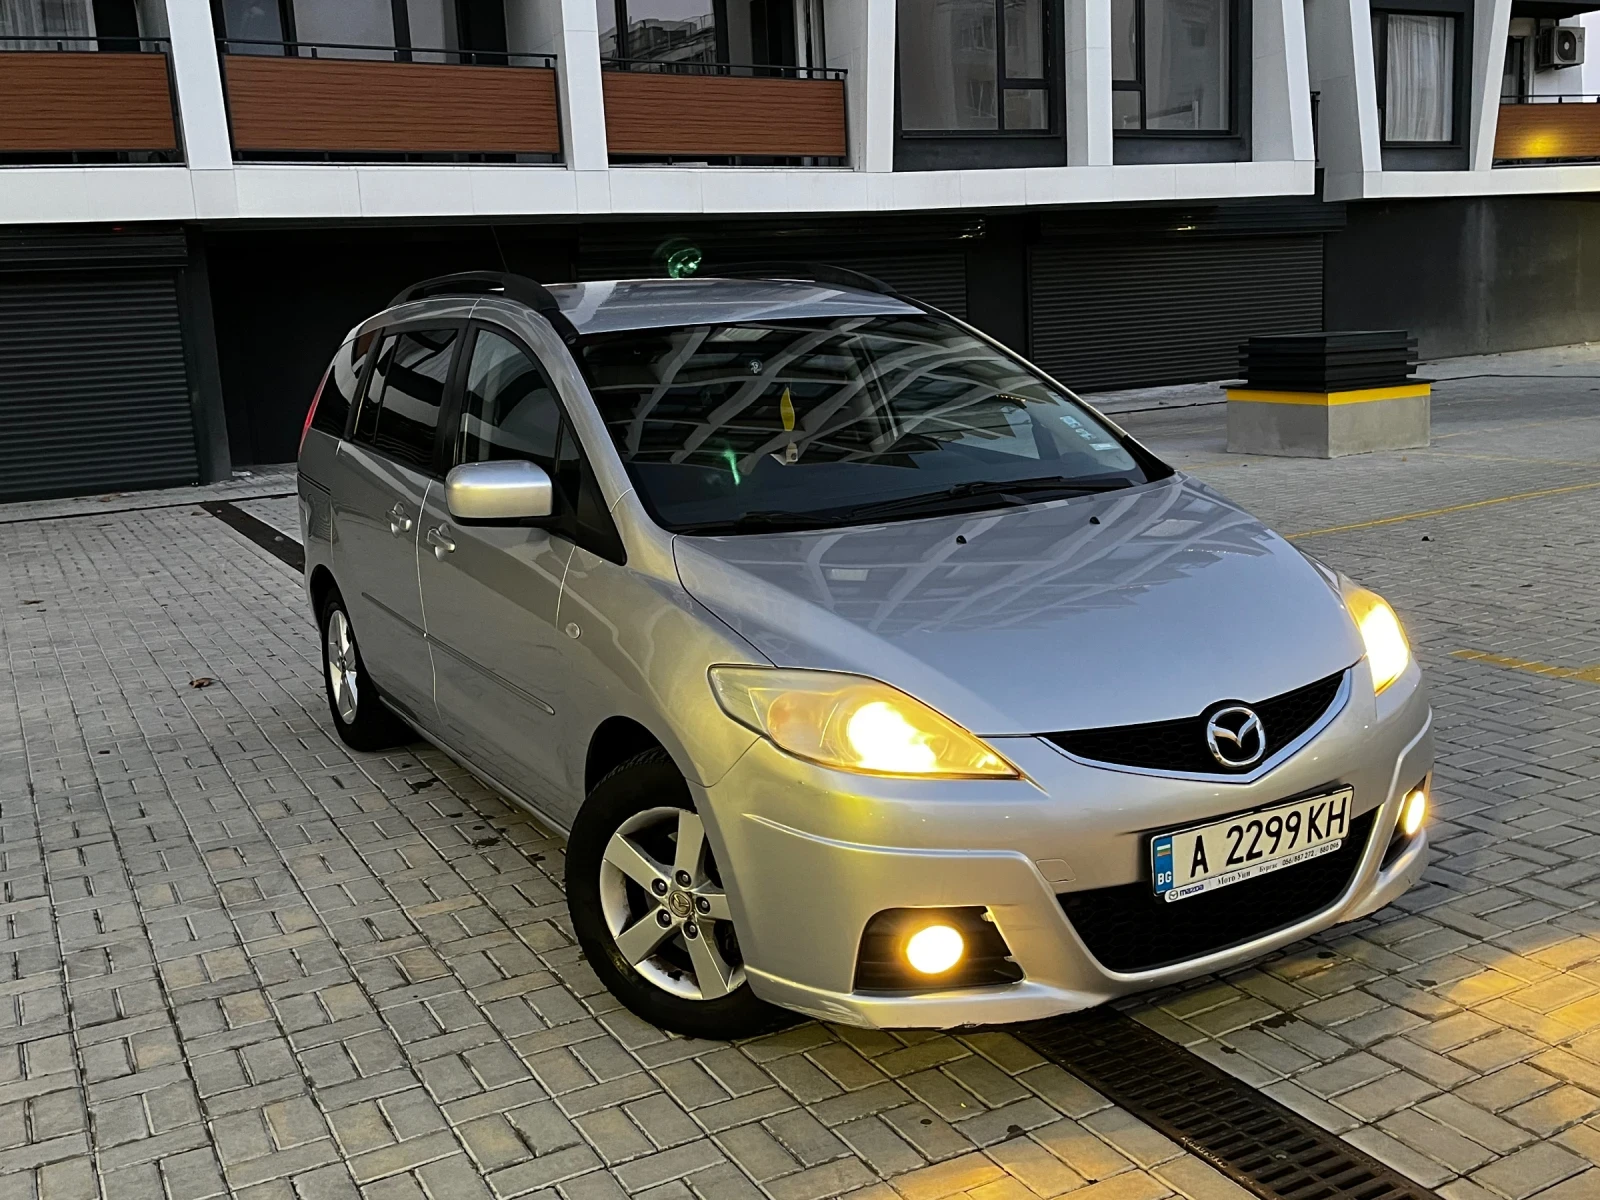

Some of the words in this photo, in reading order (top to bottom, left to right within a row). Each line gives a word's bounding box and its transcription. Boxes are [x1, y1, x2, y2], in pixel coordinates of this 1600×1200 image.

[1189, 834, 1209, 878] A
[1157, 870, 1172, 886] BG
[1179, 883, 1205, 897] mazda
